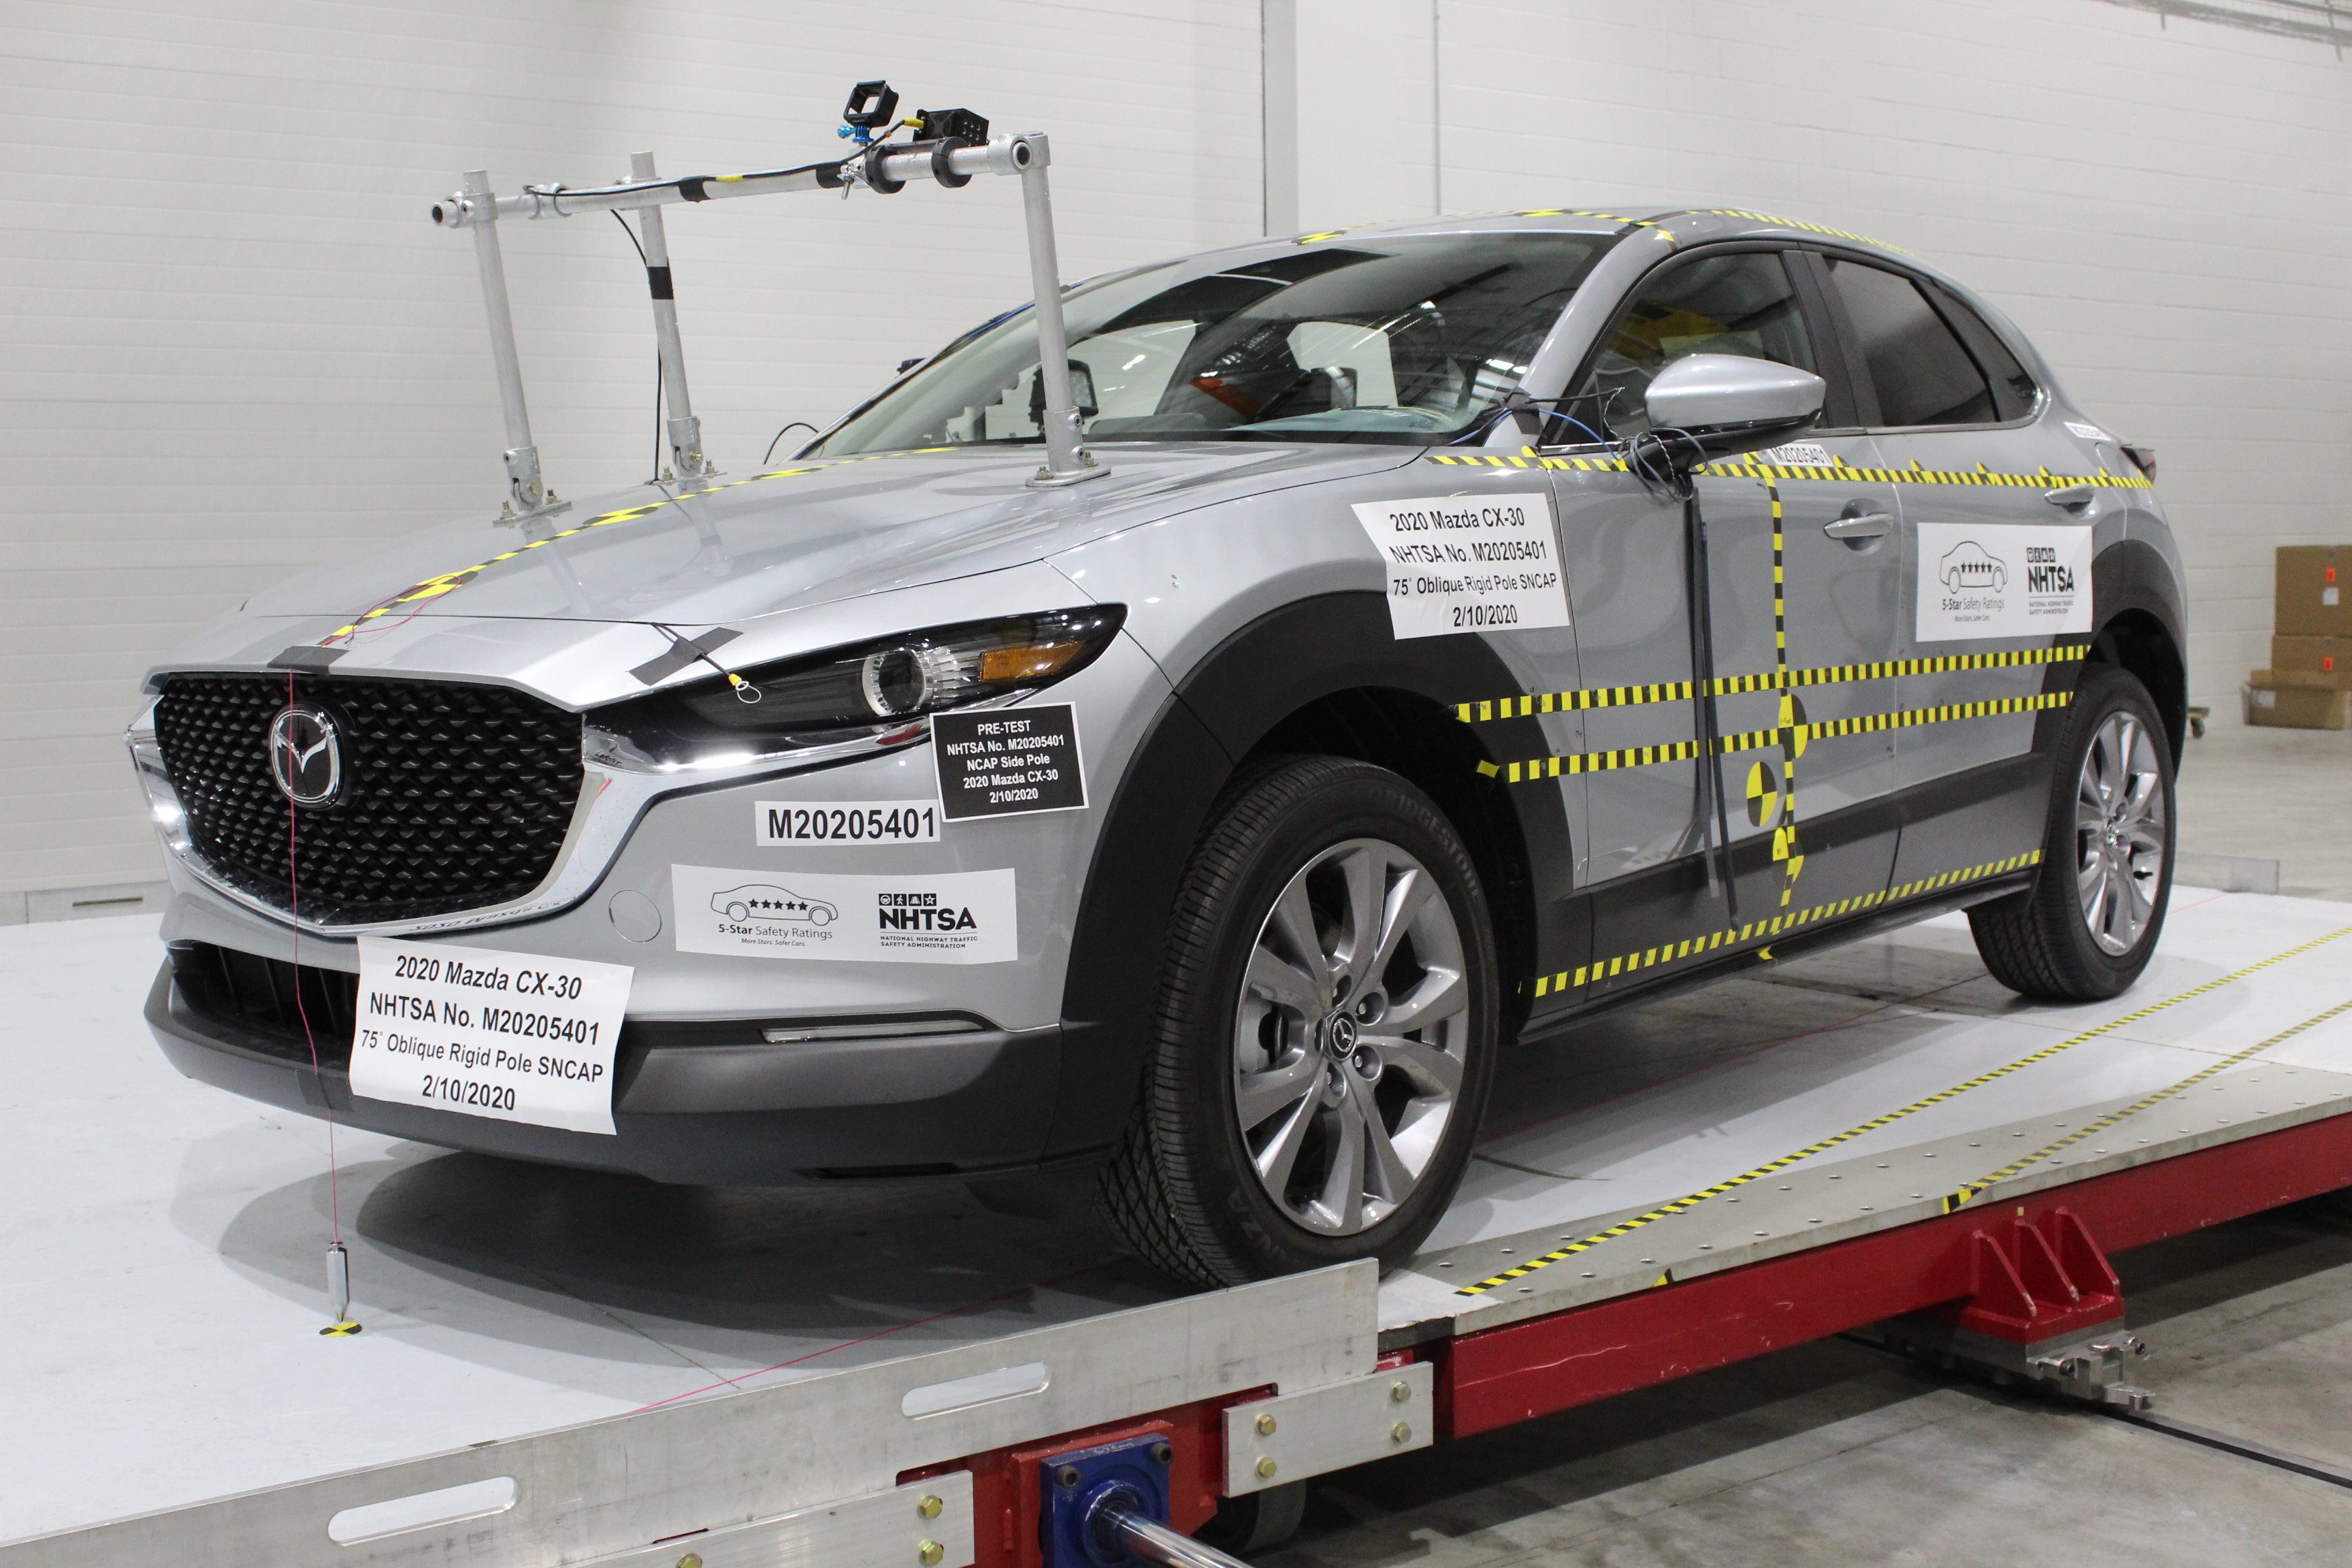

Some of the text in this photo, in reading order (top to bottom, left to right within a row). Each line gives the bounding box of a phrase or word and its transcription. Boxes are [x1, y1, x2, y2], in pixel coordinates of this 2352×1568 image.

[1771, 446, 1831, 464] M20205401
[1390, 507, 1525, 532] 2020 Mazda CX-30
[1389, 540, 1547, 564] NHTSA No. M20205401
[1417, 576, 1464, 596] Oblique
[1464, 575, 1492, 595] Rigid
[1494, 574, 1518, 592] Pole
[1520, 572, 1556, 590] SNCAP
[2027, 566, 2074, 592] NHTSA
[1454, 604, 1518, 627] 2/10/2020
[1942, 597, 2005, 614] 5-Star Safety Ratings
[977, 719, 1031, 736] PRE-TEST
[947, 734, 1064, 756] NHTSA No. M20205401
[966, 753, 1051, 771] NCAP Side Pole
[963, 769, 1059, 789] 2020 Mazda CX-30
[989, 787, 1039, 804] 2/10/2020
[768, 807, 935, 840] M20205401
[879, 907, 977, 931] NHTSA
[719, 924, 833, 941] 5-Star Safety Ratings
[395, 955, 583, 1000] 2020 Mazda CX-30
[370, 992, 600, 1046] NHTSA No. M20205401
[387, 1033, 445, 1062] Oblique
[448, 1043, 491, 1069] Rigid
[495, 1049, 532, 1073] Pole
[537, 1055, 604, 1083] SNCAP
[422, 1074, 516, 1111] 2/10/2020
